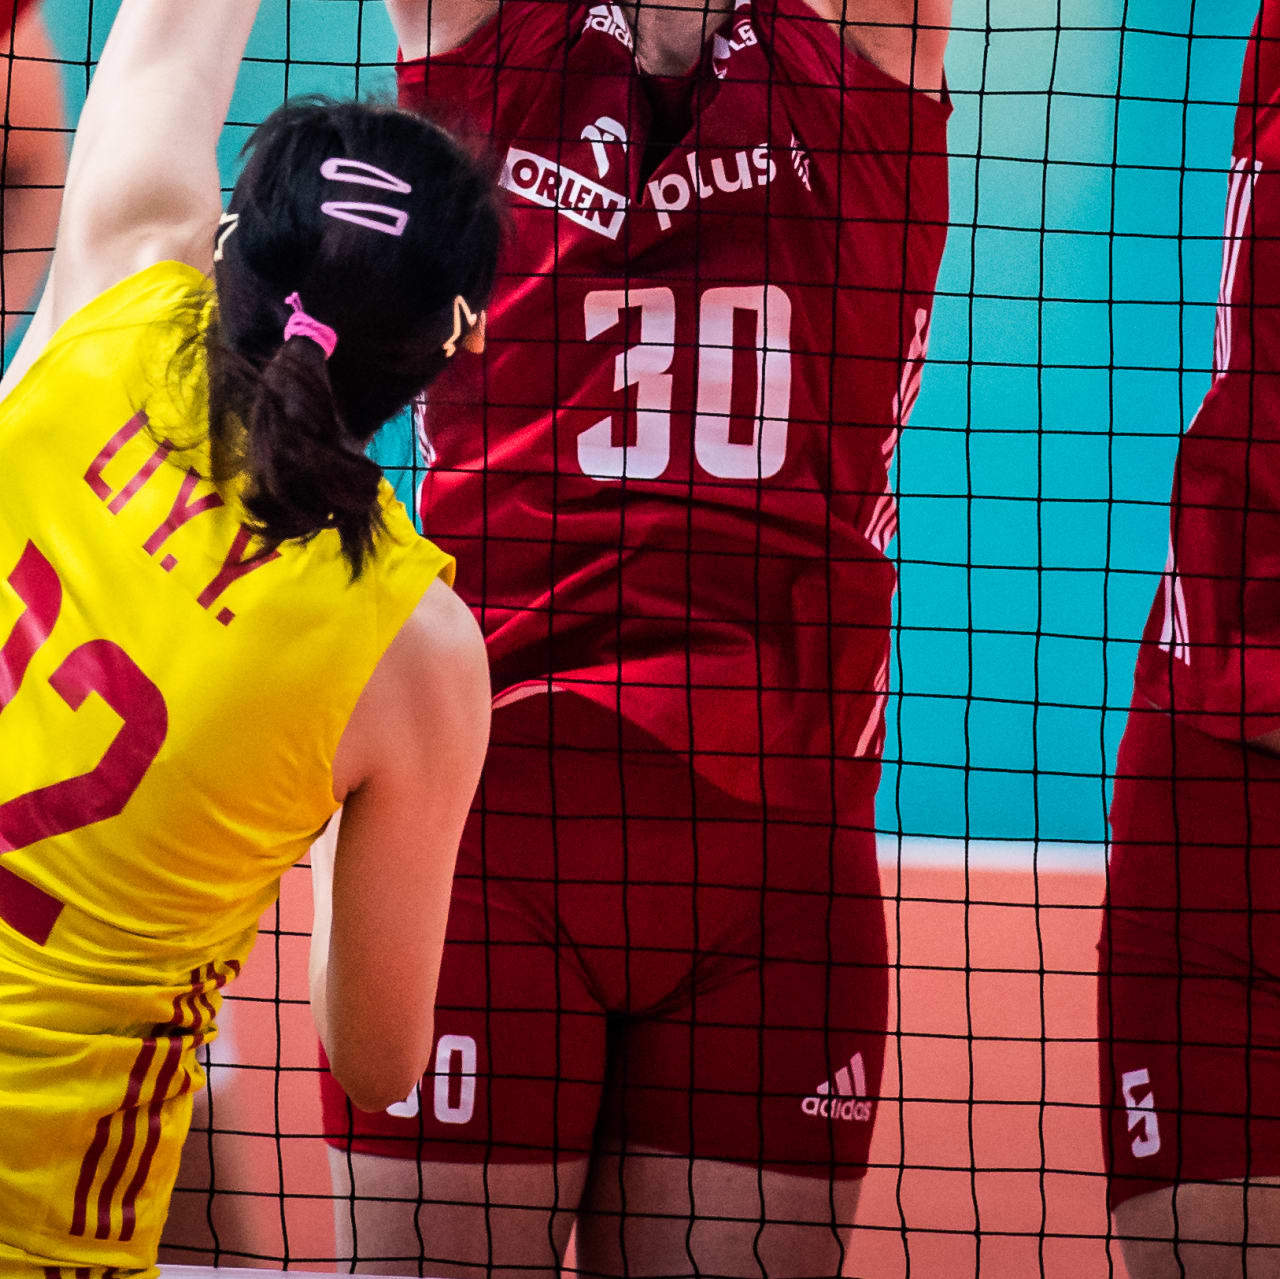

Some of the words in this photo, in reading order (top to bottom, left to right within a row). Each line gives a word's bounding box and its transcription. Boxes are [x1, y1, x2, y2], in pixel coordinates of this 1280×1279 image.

[511, 157, 619, 230] ORLEN
[647, 142, 777, 232] plus
[577, 284, 793, 482] 30
[1121, 1067, 1161, 1158] 5
